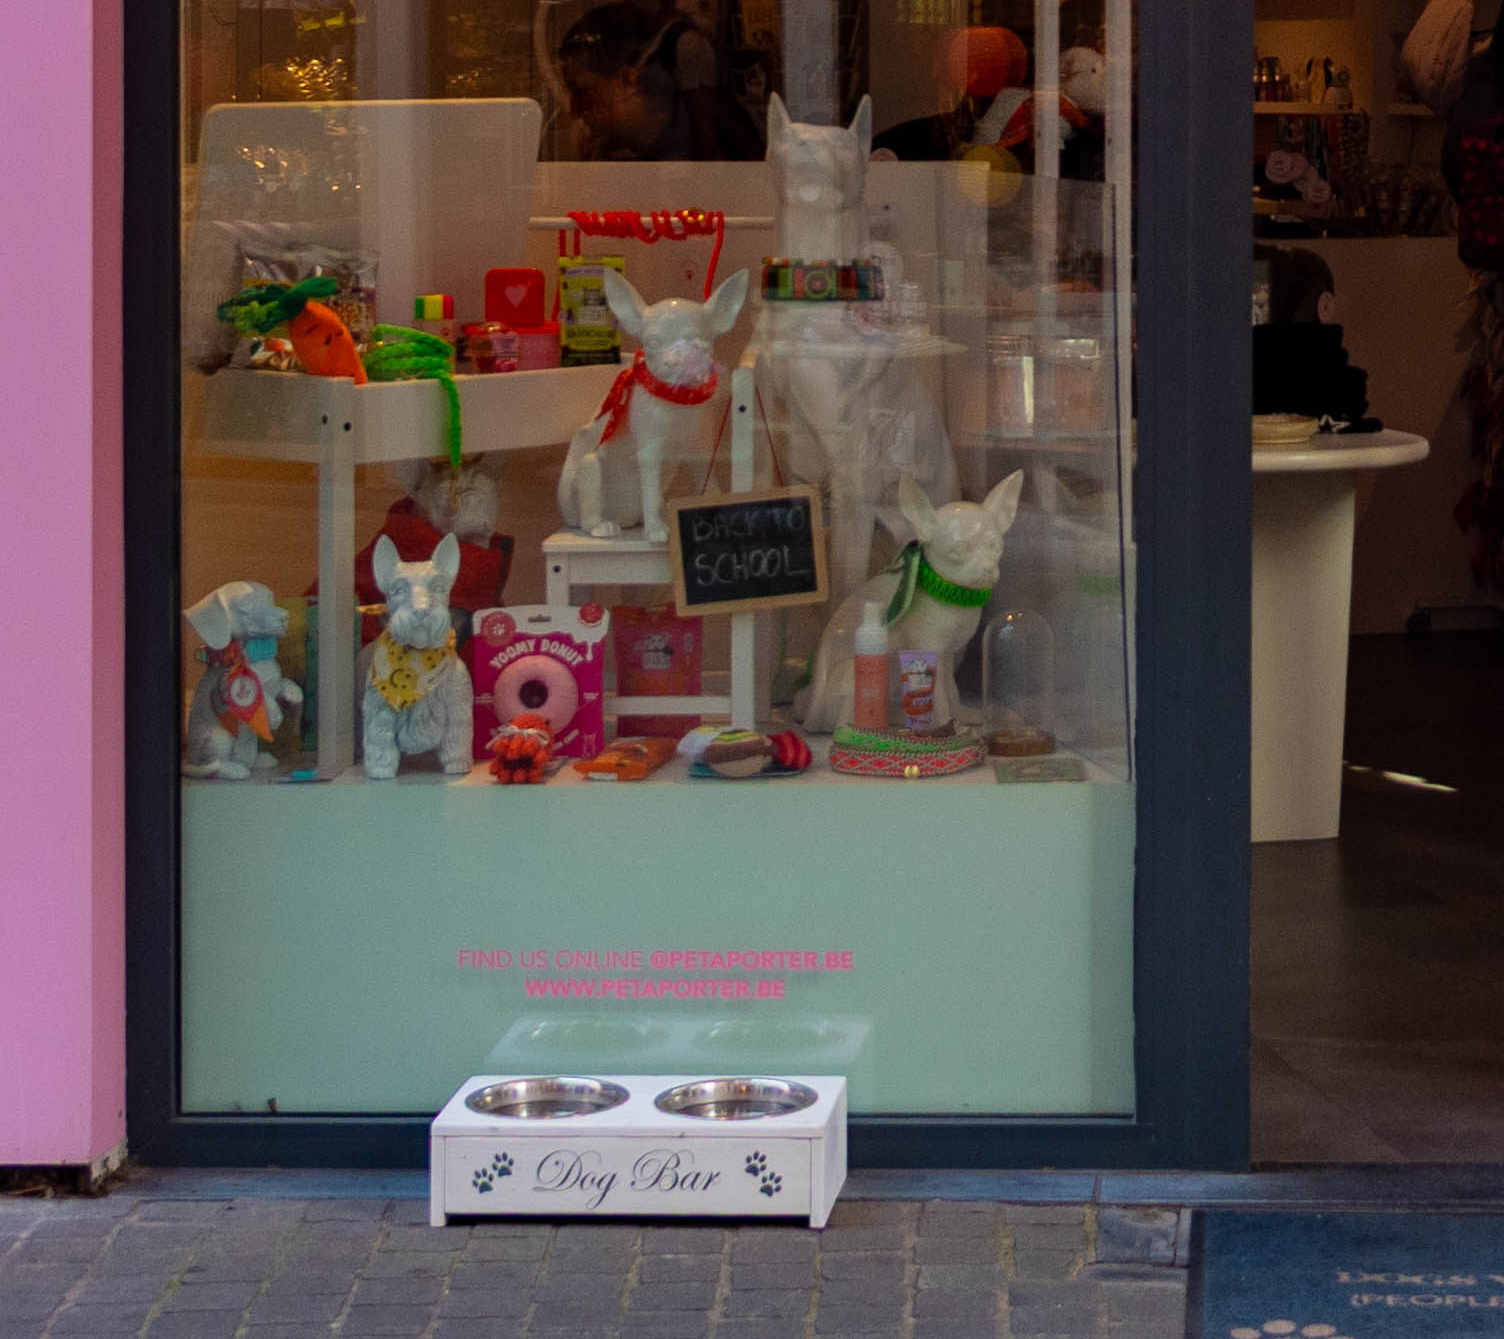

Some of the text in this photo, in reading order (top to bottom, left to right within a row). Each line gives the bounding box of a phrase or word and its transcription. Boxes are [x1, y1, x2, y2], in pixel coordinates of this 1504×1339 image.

[769, 505, 806, 531] TO
[695, 544, 813, 587] SCHOOL
[490, 638, 586, 668] YOOMY DONUT
[458, 950, 855, 973] FIND US ONLINE @PETAPORTER.BE
[524, 979, 786, 1000] WWW.PETAPORTER.BE
[533, 1148, 722, 1209] Dog Bar
